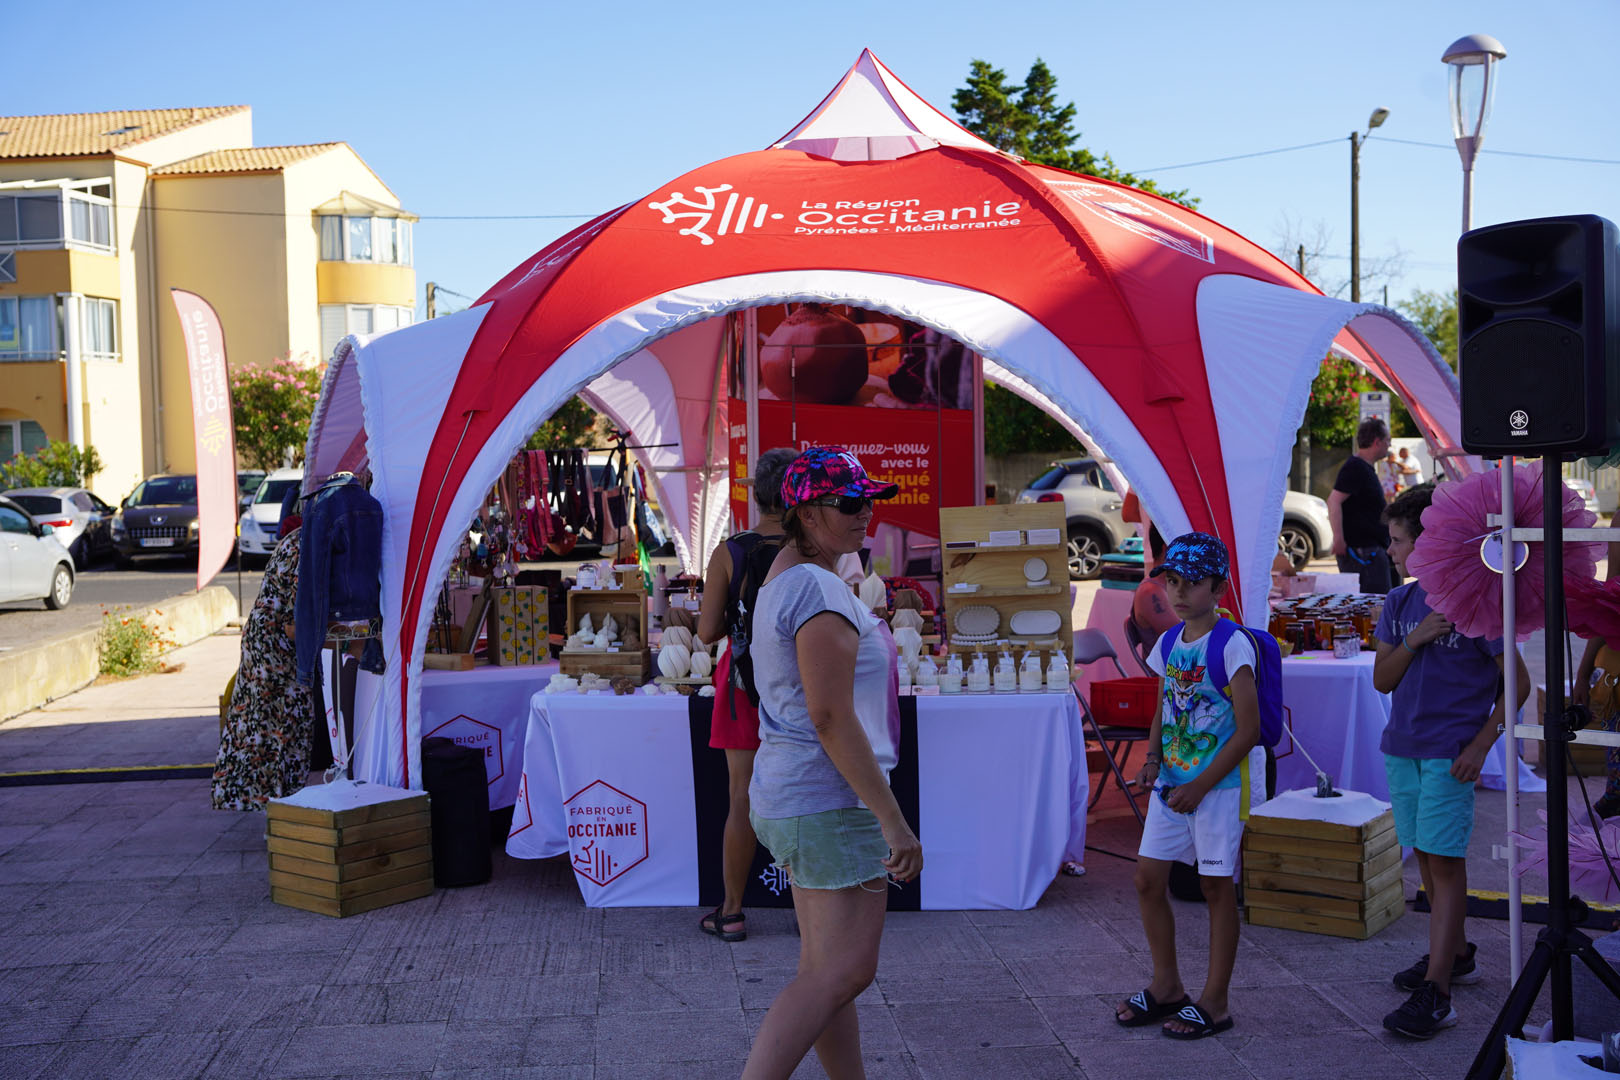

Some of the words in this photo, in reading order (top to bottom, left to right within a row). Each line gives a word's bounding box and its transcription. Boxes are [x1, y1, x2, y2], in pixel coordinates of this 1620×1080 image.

[801, 201, 827, 209] La
[835, 199, 920, 210] Région
[798, 201, 1021, 226] Occitanie
[794, 226, 878, 236] Pyrénées
[895, 217, 1021, 233] Méditerranée
[881, 459, 912, 468] avec
[916, 457, 929, 468] le
[570, 805, 632, 816] FABRIQUÉ
[568, 822, 637, 838] OCCITANIE
